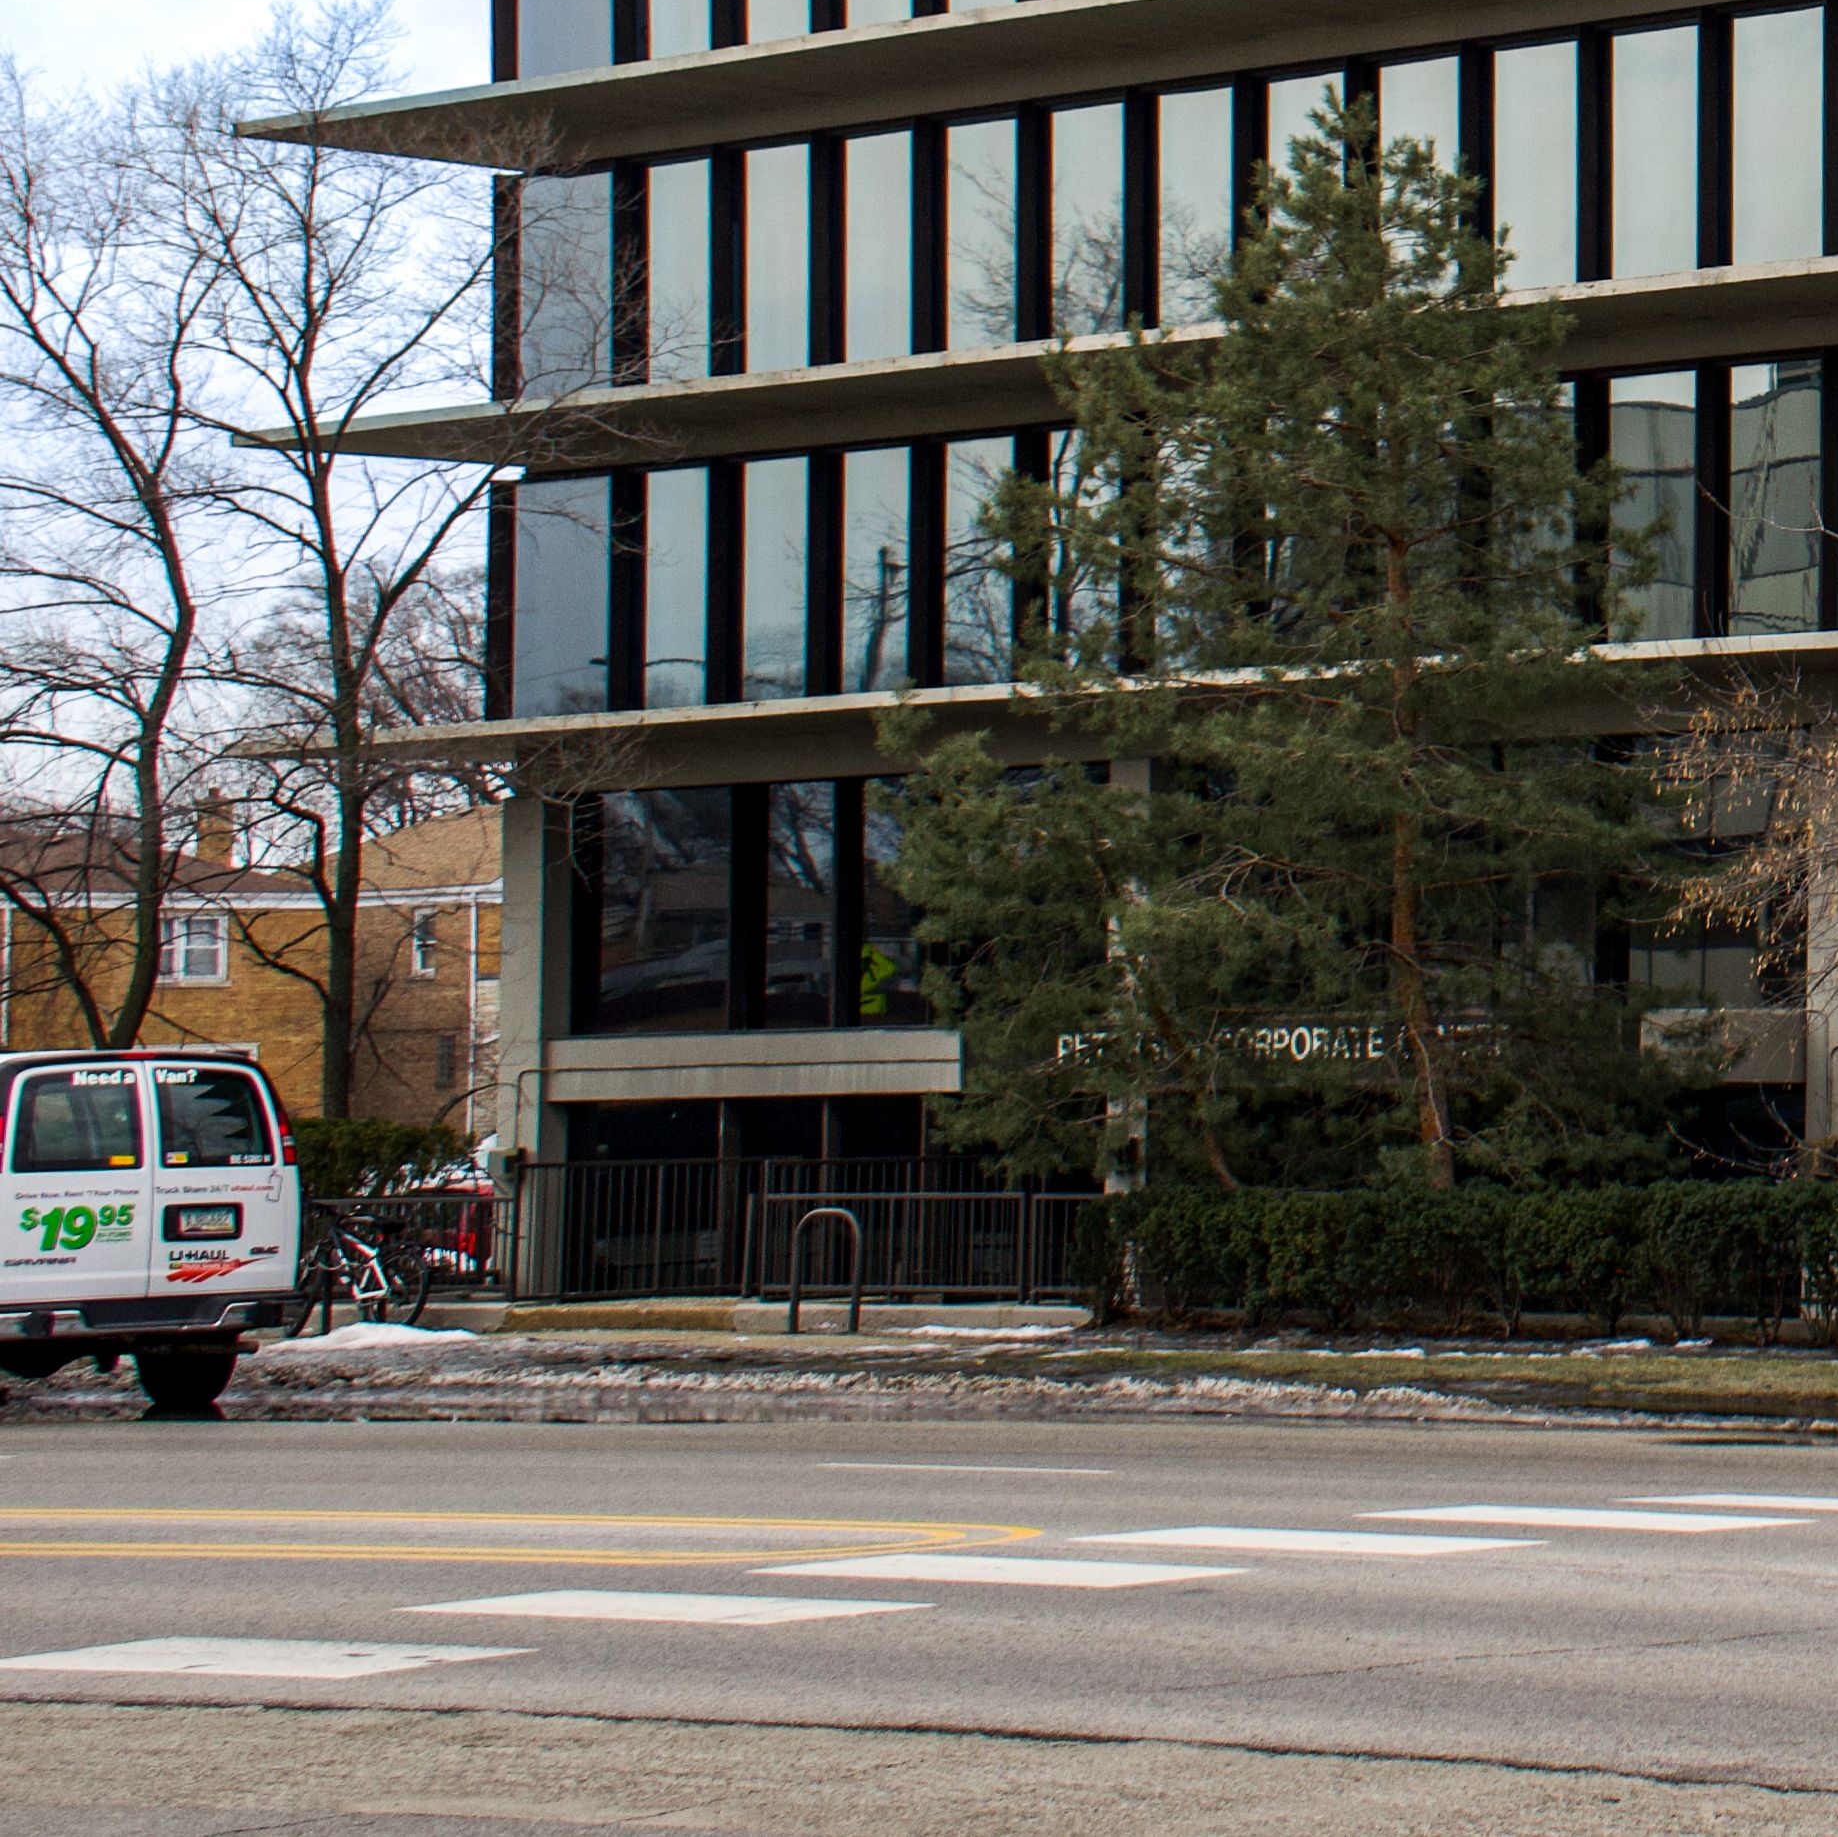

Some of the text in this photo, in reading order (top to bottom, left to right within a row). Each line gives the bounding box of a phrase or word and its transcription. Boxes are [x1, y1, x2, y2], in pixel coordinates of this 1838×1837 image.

[72, 1068, 198, 1085] Need a Van?
